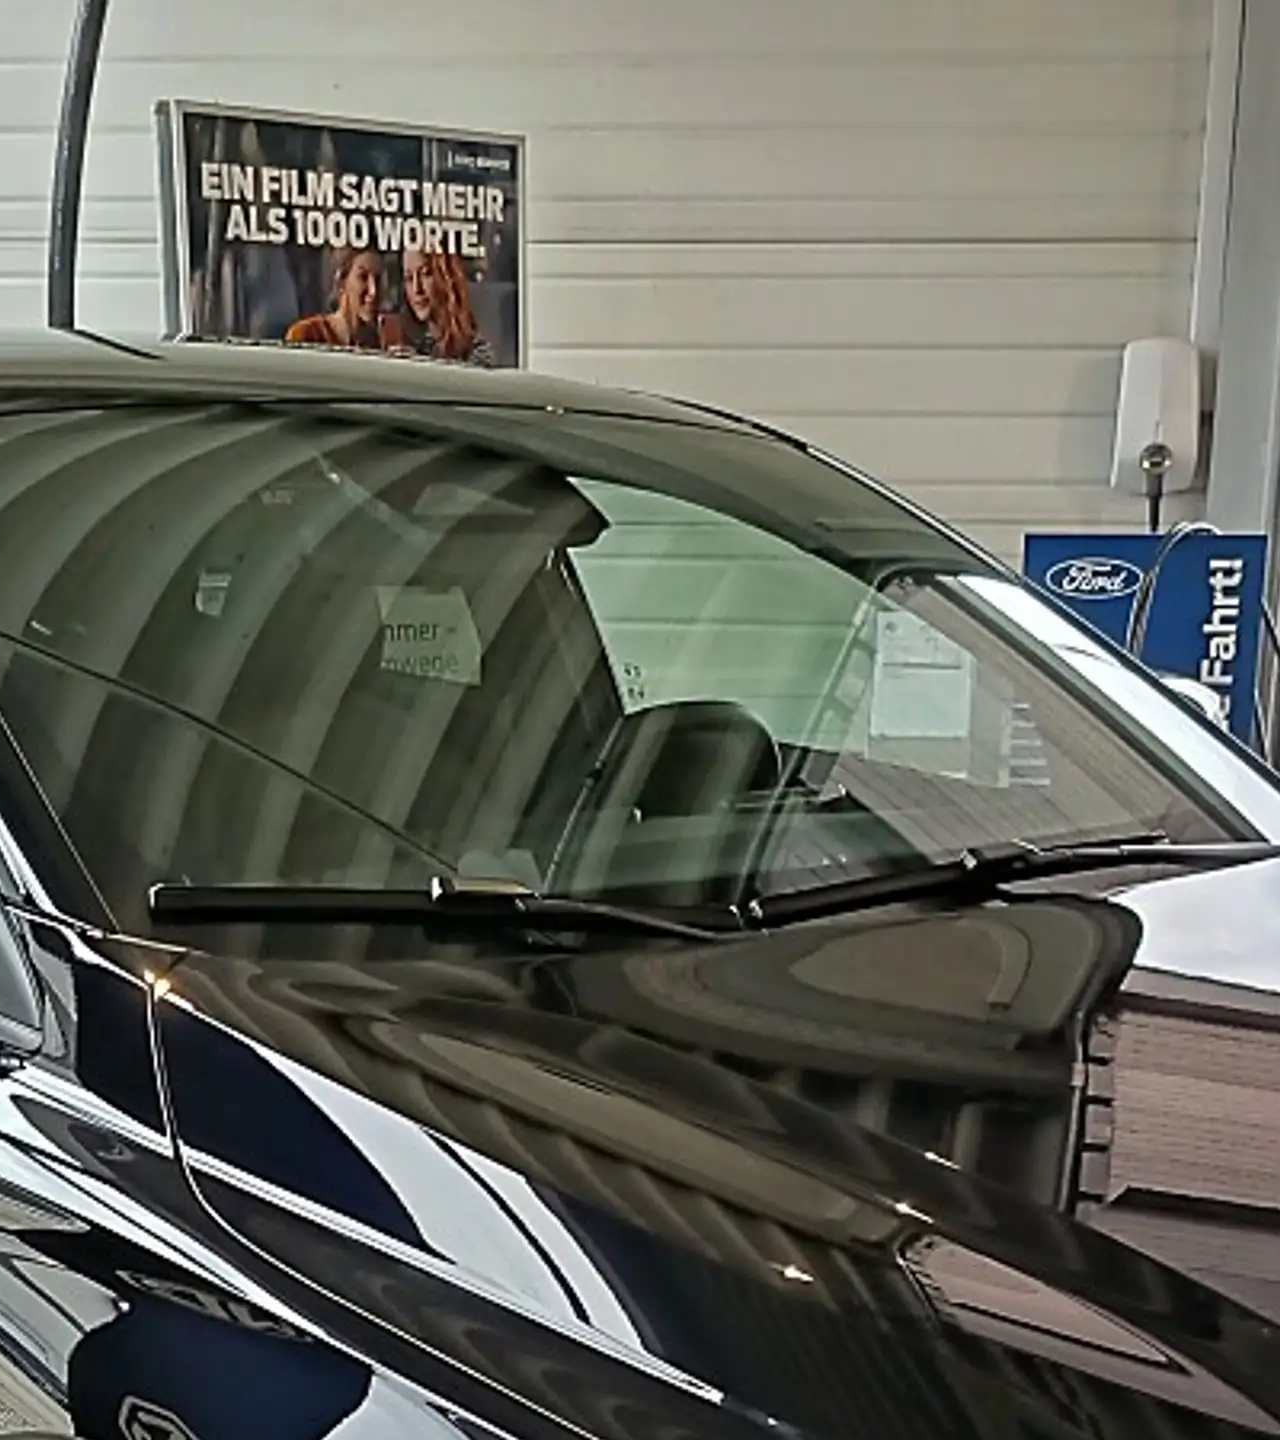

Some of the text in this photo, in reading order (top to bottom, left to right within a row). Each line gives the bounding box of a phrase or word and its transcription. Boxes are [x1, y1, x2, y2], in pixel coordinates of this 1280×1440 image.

[200, 162, 504, 222] EIN FILM SAGT MEHR
[225, 206, 487, 257] ALS 1000 WORTE.
[1061, 560, 1126, 591] Ford
[1200, 558, 1244, 686] Fahrt!
